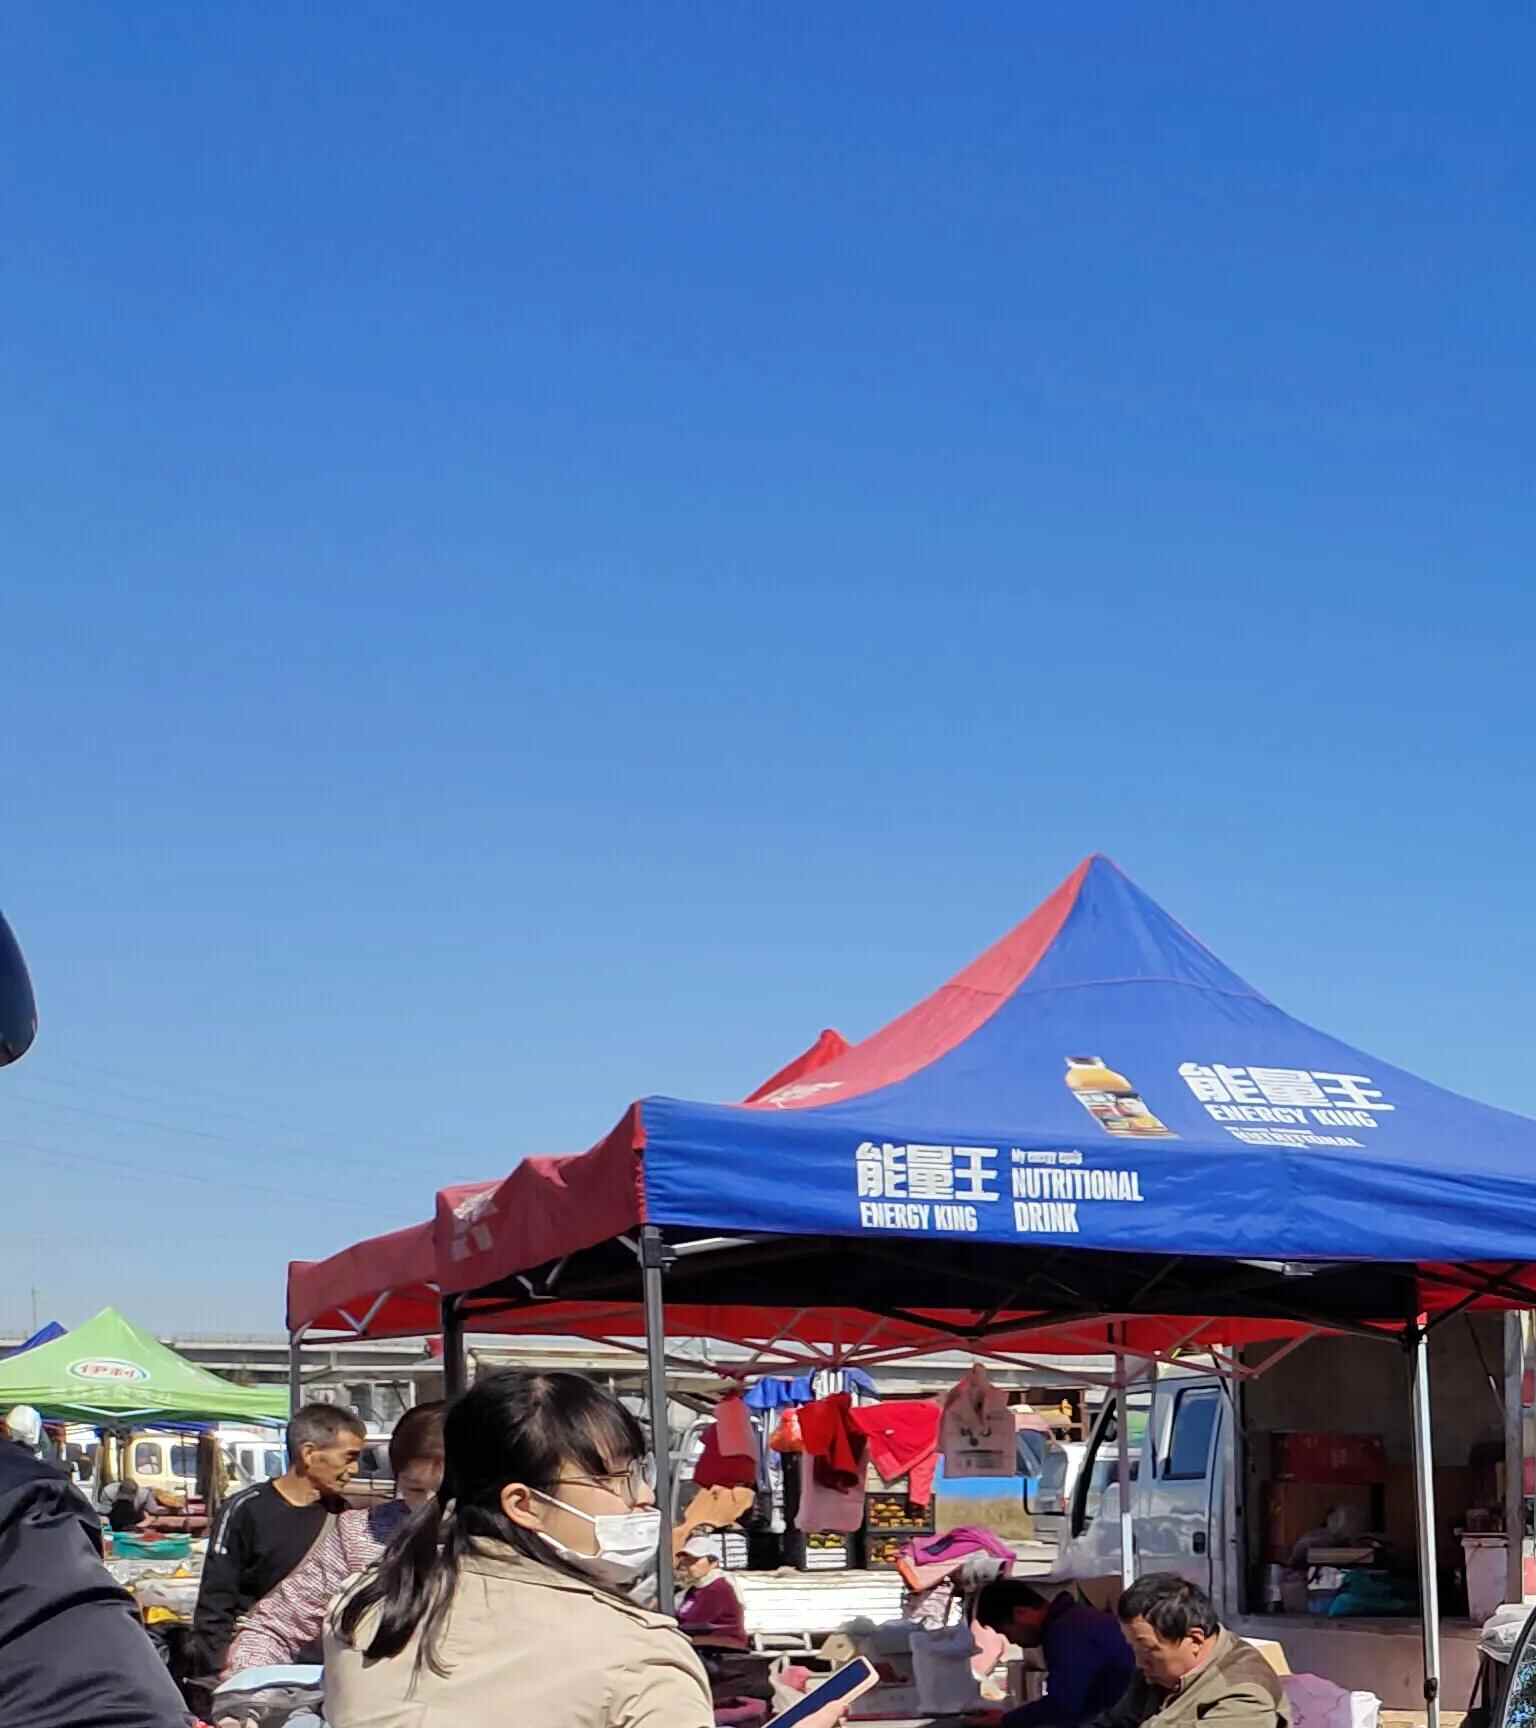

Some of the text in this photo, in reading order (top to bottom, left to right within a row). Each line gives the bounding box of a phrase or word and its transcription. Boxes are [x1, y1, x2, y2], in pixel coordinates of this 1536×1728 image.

[1178, 1062, 1395, 1110] 能量王
[1203, 1104, 1378, 1128] ENERGY KING
[856, 1142, 1000, 1201] 能量王
[1011, 1167, 1145, 1201] NUTRITIONAL
[860, 1201, 978, 1232] ENERGY KING
[1013, 1201, 1080, 1233] DRINK
